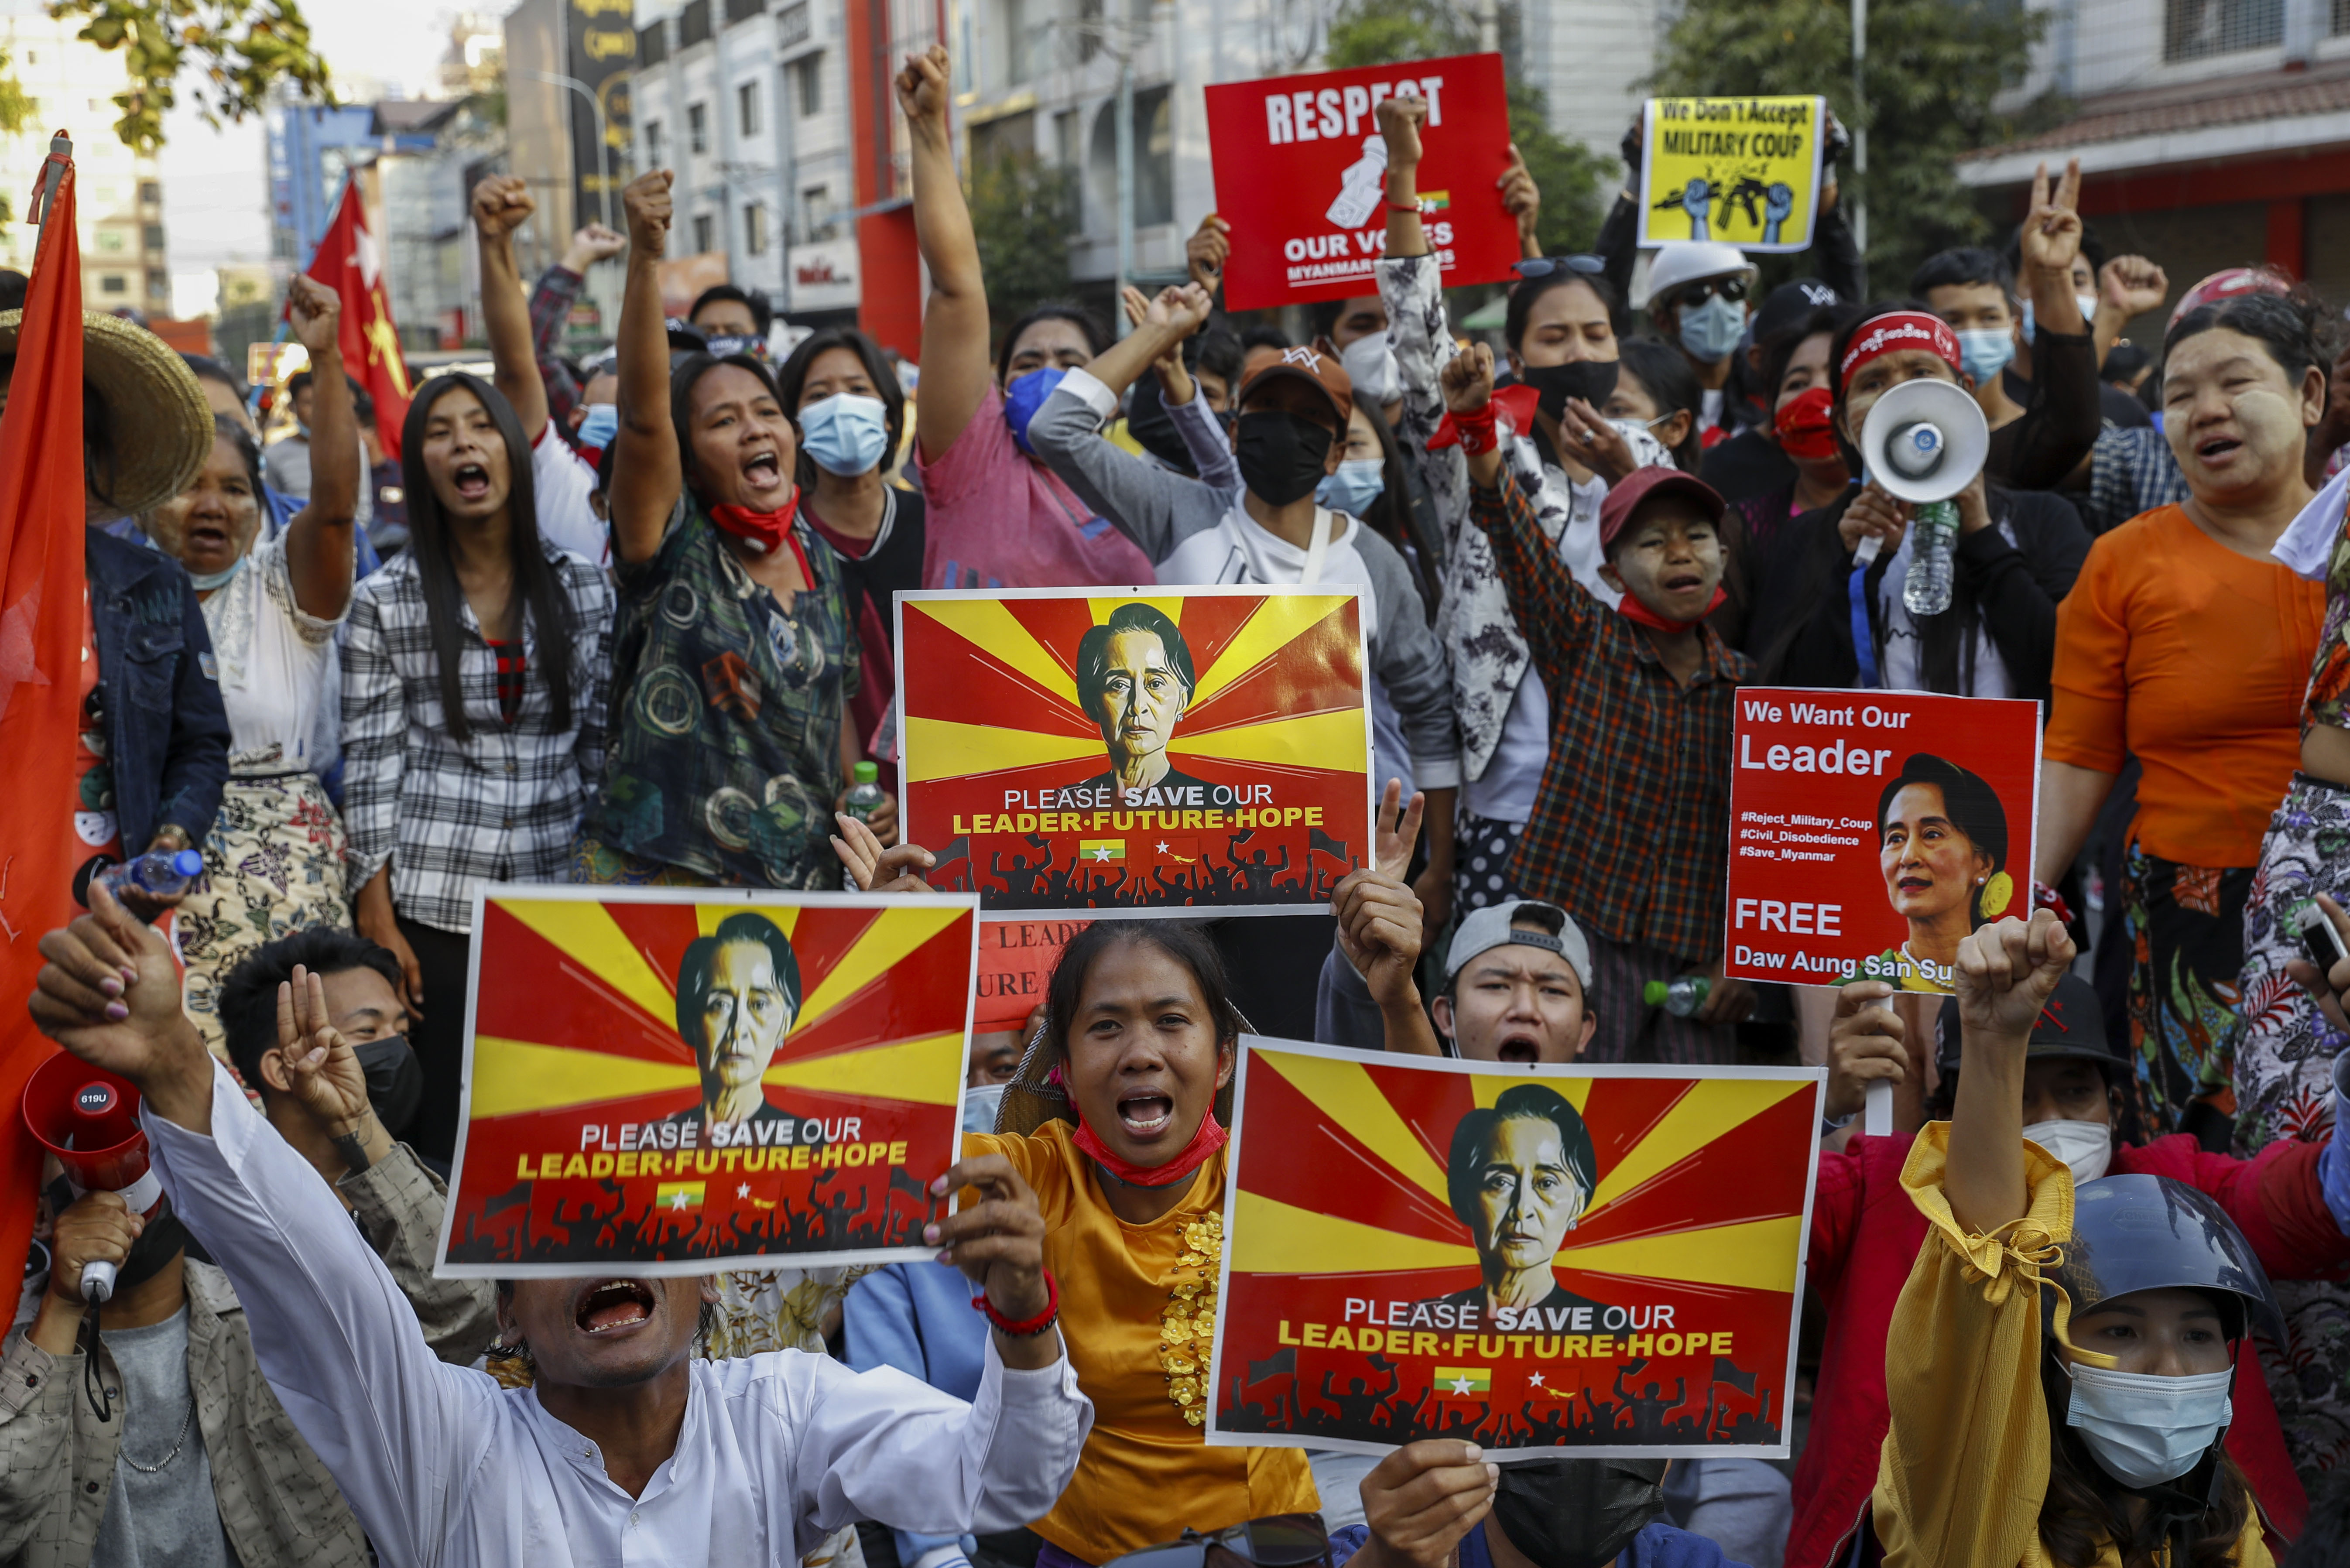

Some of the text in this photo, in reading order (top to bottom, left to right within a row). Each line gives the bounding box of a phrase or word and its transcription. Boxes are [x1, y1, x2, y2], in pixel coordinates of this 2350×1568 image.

[1662, 99, 1688, 121] We
[1748, 100, 1808, 130] Accept
[1663, 130, 1803, 159] MILITARY COUP
[1284, 221, 1454, 262] OUR VOES
[1744, 701, 1911, 729] We Want Our
[1740, 734, 1891, 776] Leader
[1005, 784, 1273, 810] PLEASE SAVE OUR
[1741, 812, 1873, 831] #Reject_Military_Coup
[1740, 829, 1860, 846] #Civil_Disobedience
[1740, 846, 1836, 862] #Save_Myanmar
[1735, 898, 1842, 936] FREE
[1735, 945, 1953, 981] Daw Aung San Su
[81, 1094, 106, 1103] 619U
[581, 1117, 861, 1153] PLEASE SAVE OUR
[1344, 1298, 1675, 1331] PLEASE SAVE OUR
